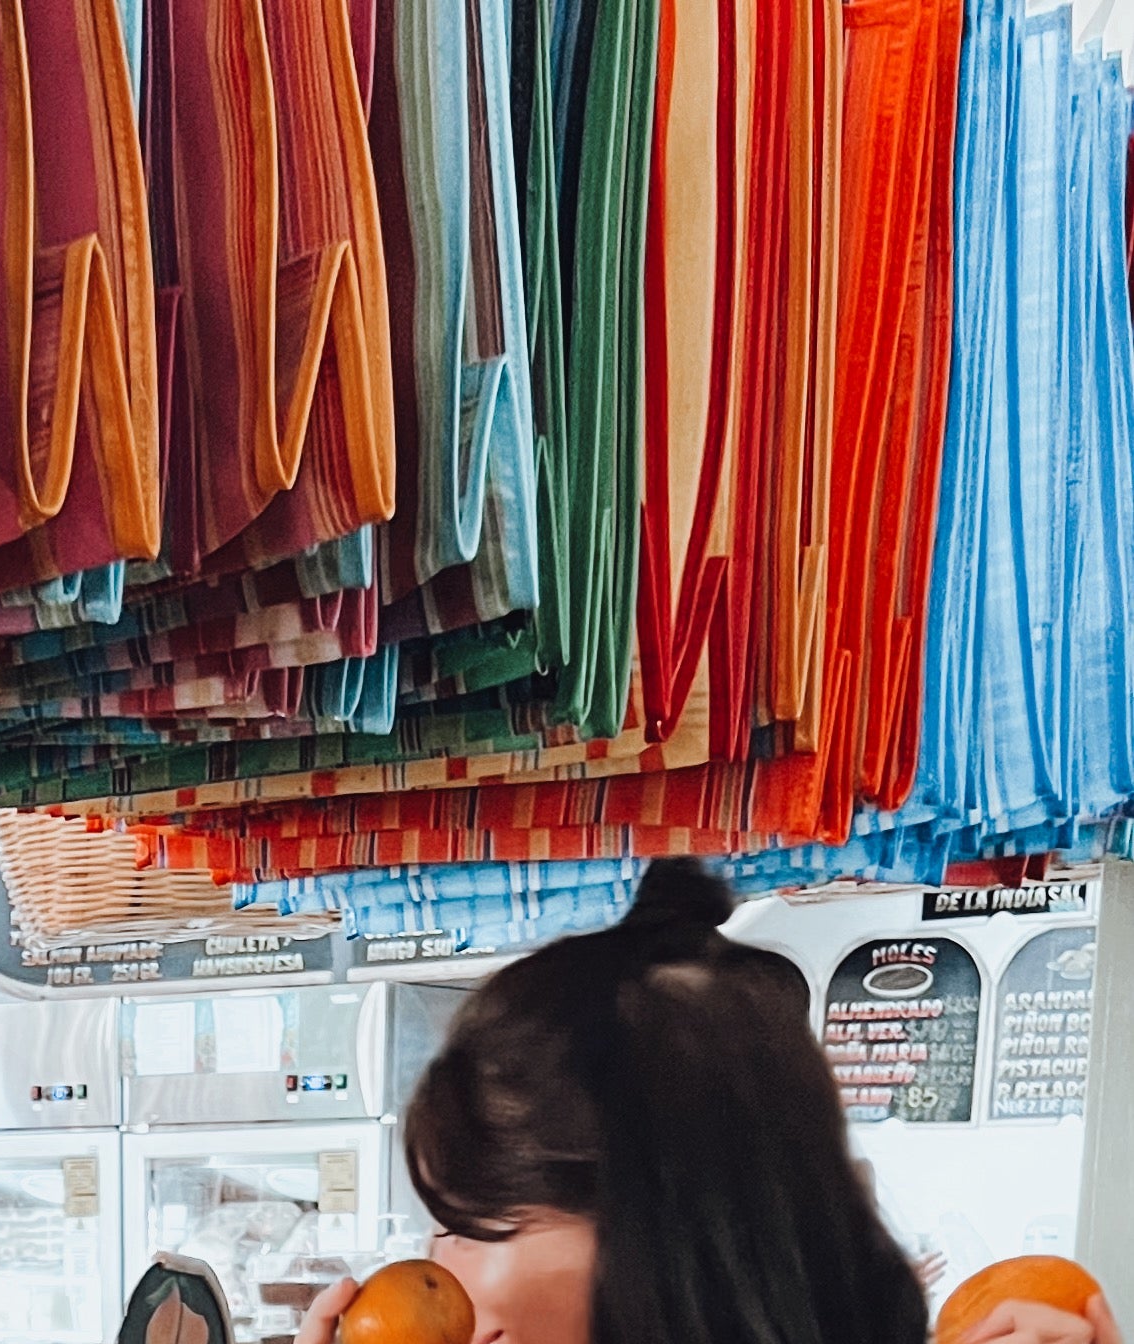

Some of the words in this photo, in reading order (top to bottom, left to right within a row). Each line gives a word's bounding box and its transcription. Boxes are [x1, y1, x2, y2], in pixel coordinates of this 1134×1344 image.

[934, 892, 963, 912] DE
[963, 891, 988, 910] LA
[991, 885, 1047, 909] INDIA
[872, 941, 938, 967] MOLES
